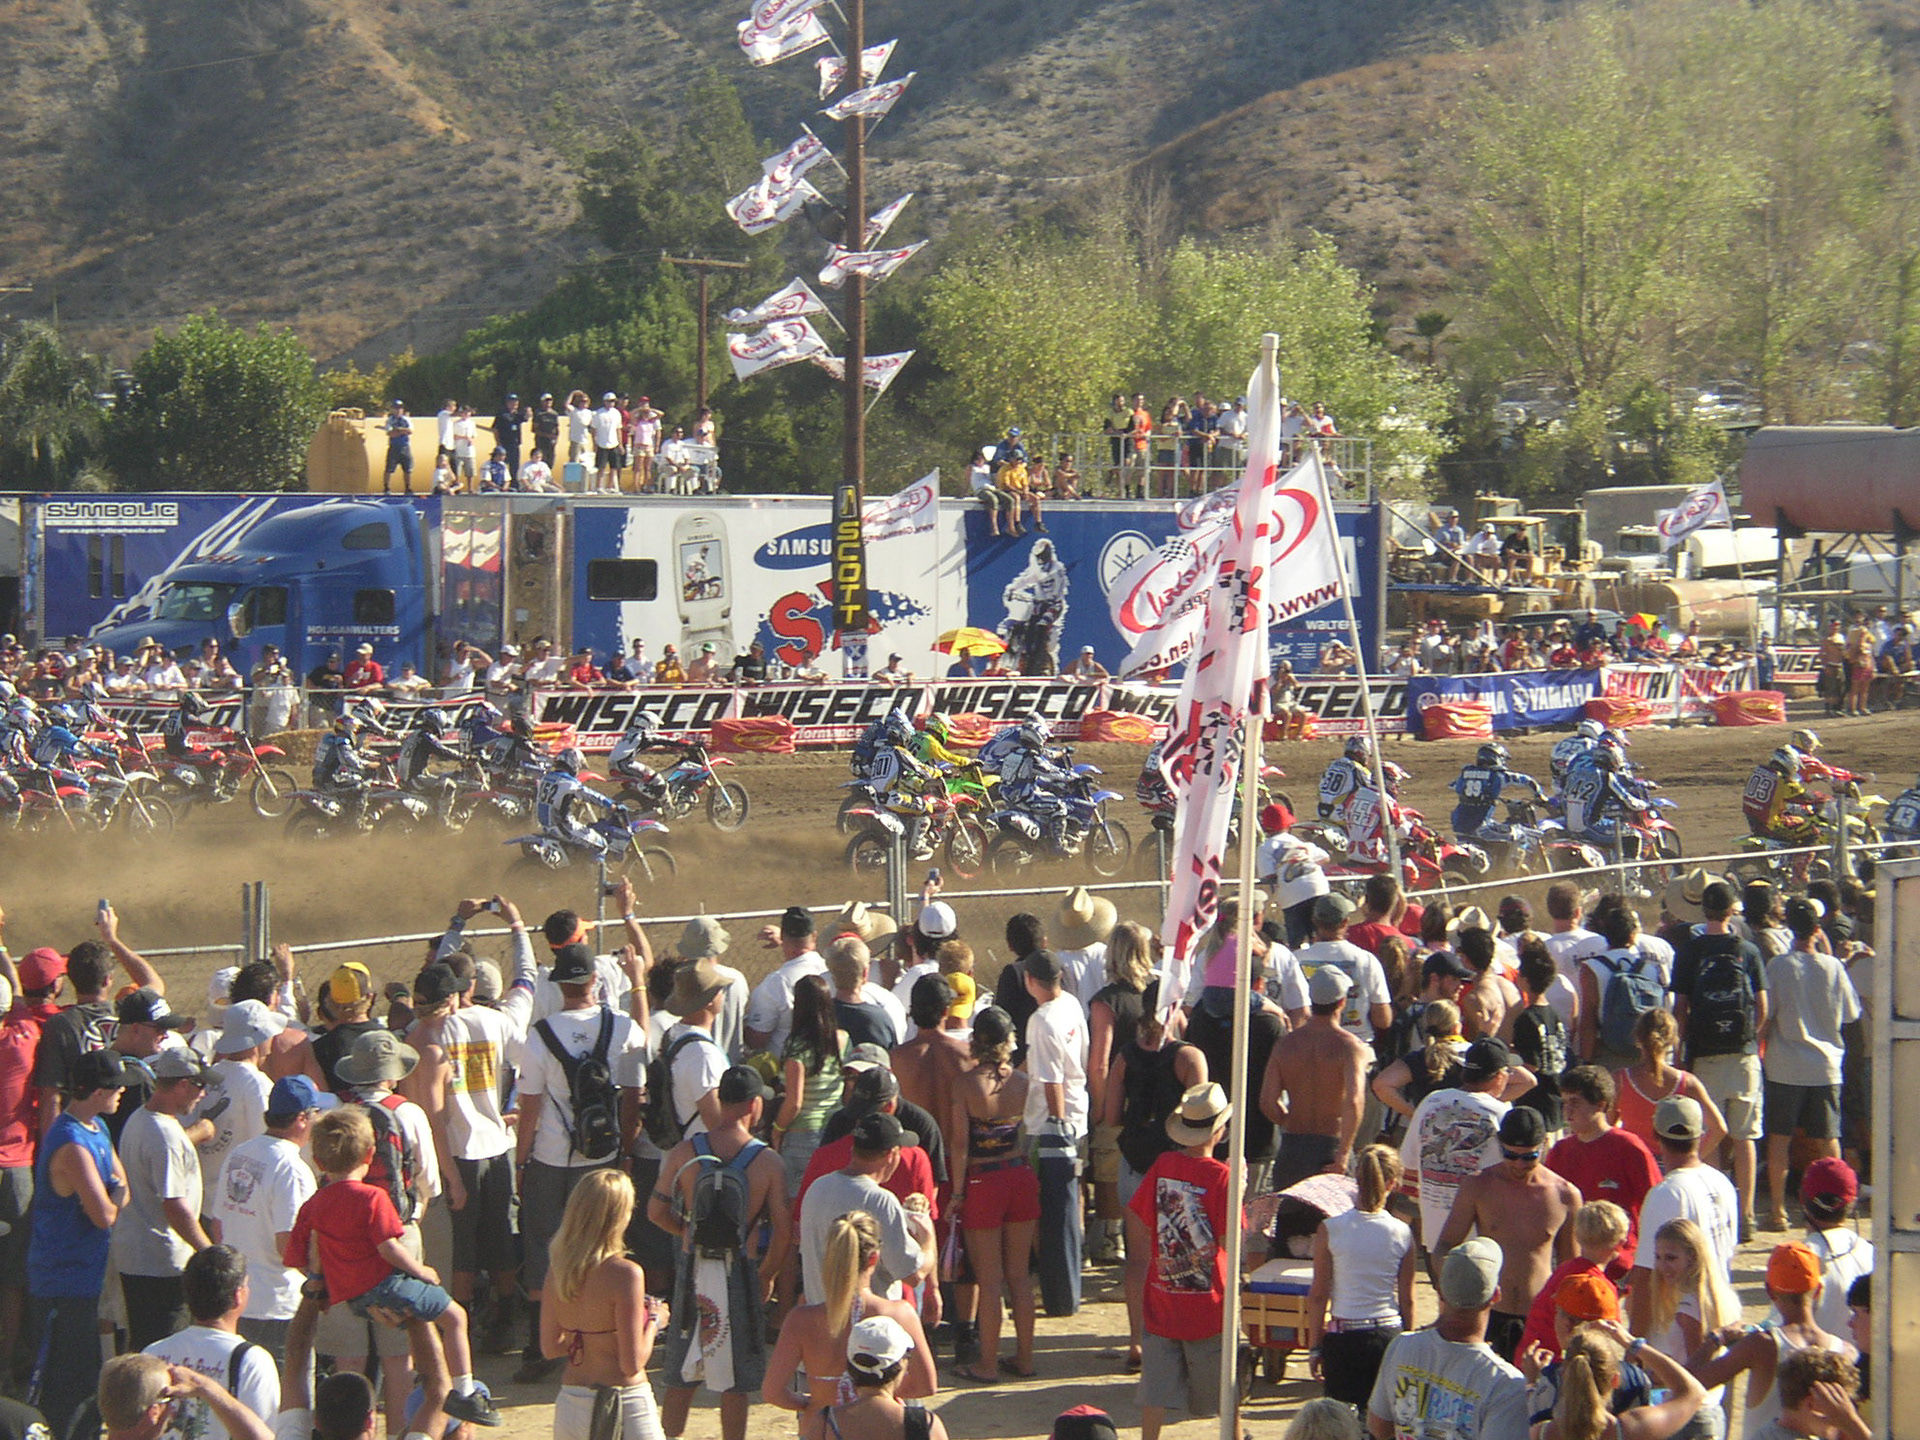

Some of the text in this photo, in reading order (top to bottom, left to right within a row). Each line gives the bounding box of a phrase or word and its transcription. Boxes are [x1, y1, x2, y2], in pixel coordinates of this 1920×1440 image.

[45, 502, 178, 519] SYMBOLIC
[766, 538, 833, 556] SAMSU
[741, 688, 924, 726] WISECO
[933, 684, 1098, 721] WISECO
[1528, 683, 1594, 711] YAMAHA
[541, 693, 732, 731] WISECO
[576, 734, 622, 747] Perfor
[793, 725, 864, 741] rformance
